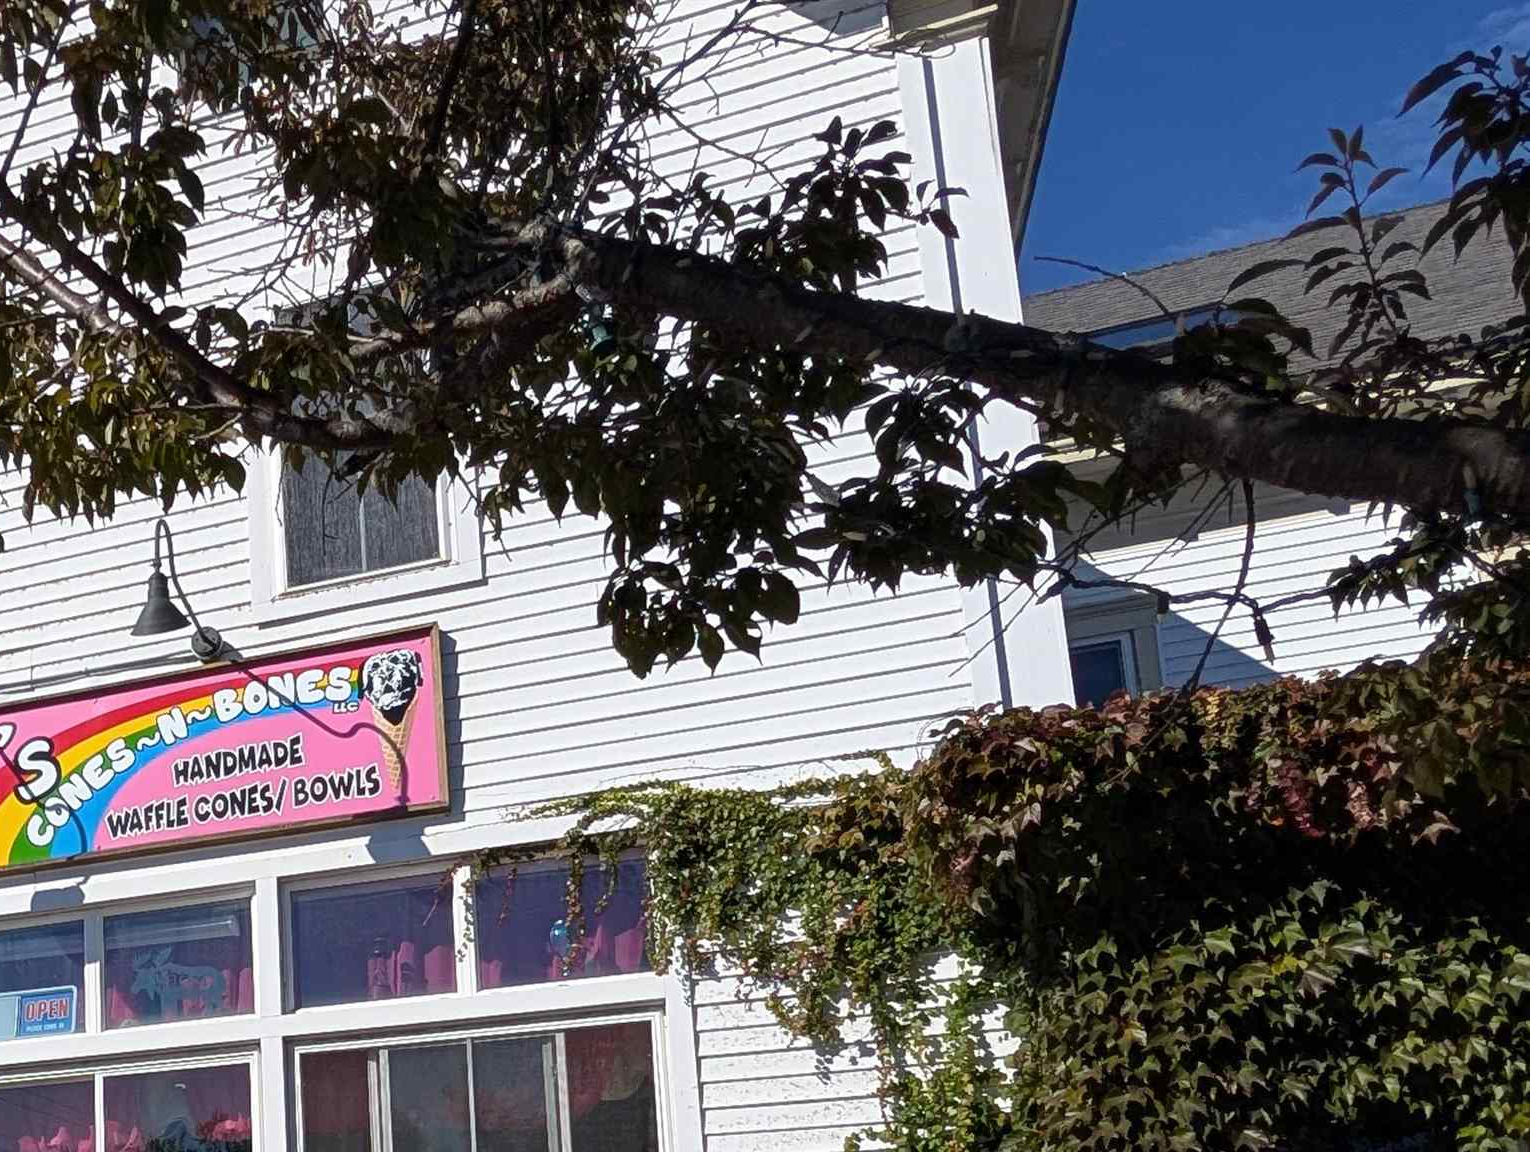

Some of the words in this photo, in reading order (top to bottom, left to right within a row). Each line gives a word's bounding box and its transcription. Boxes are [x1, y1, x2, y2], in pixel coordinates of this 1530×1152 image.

[213, 665, 354, 723] BONES
[332, 701, 359, 714] LLC
[172, 735, 304, 787] HANDMADE
[106, 797, 190, 838] WAFFLE
[292, 764, 381, 808] BOWLS
[25, 998, 70, 1021] OPEN
